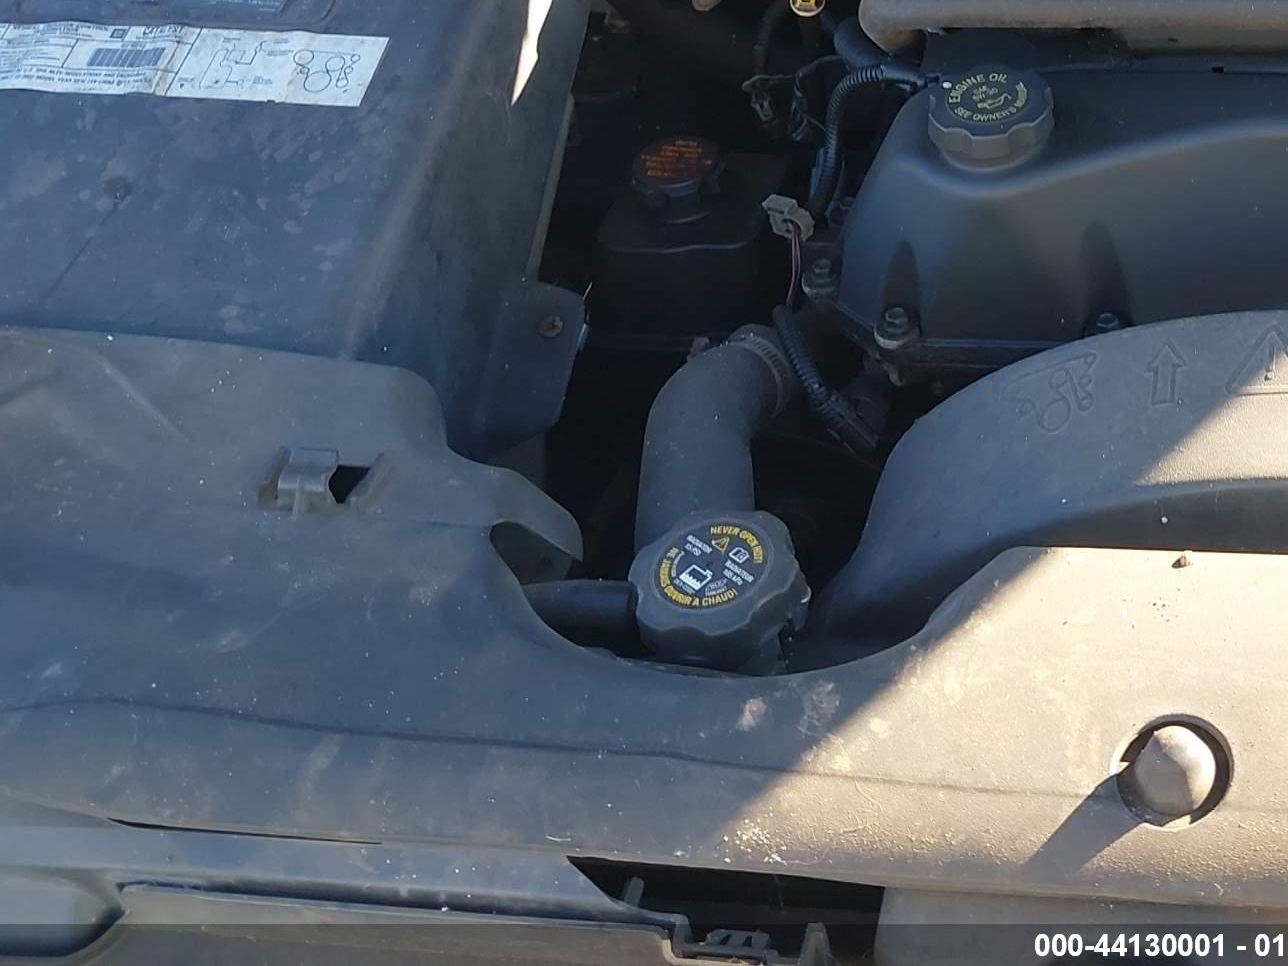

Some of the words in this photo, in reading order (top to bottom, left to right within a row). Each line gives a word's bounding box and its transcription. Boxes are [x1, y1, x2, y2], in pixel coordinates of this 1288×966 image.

[949, 73, 986, 103] ENGINE
[989, 73, 1008, 84] OIL
[954, 106, 973, 118] SEE
[710, 525, 741, 536] NEVER
[739, 530, 759, 548] OPEN
[702, 587, 738, 607] CHAUD!
